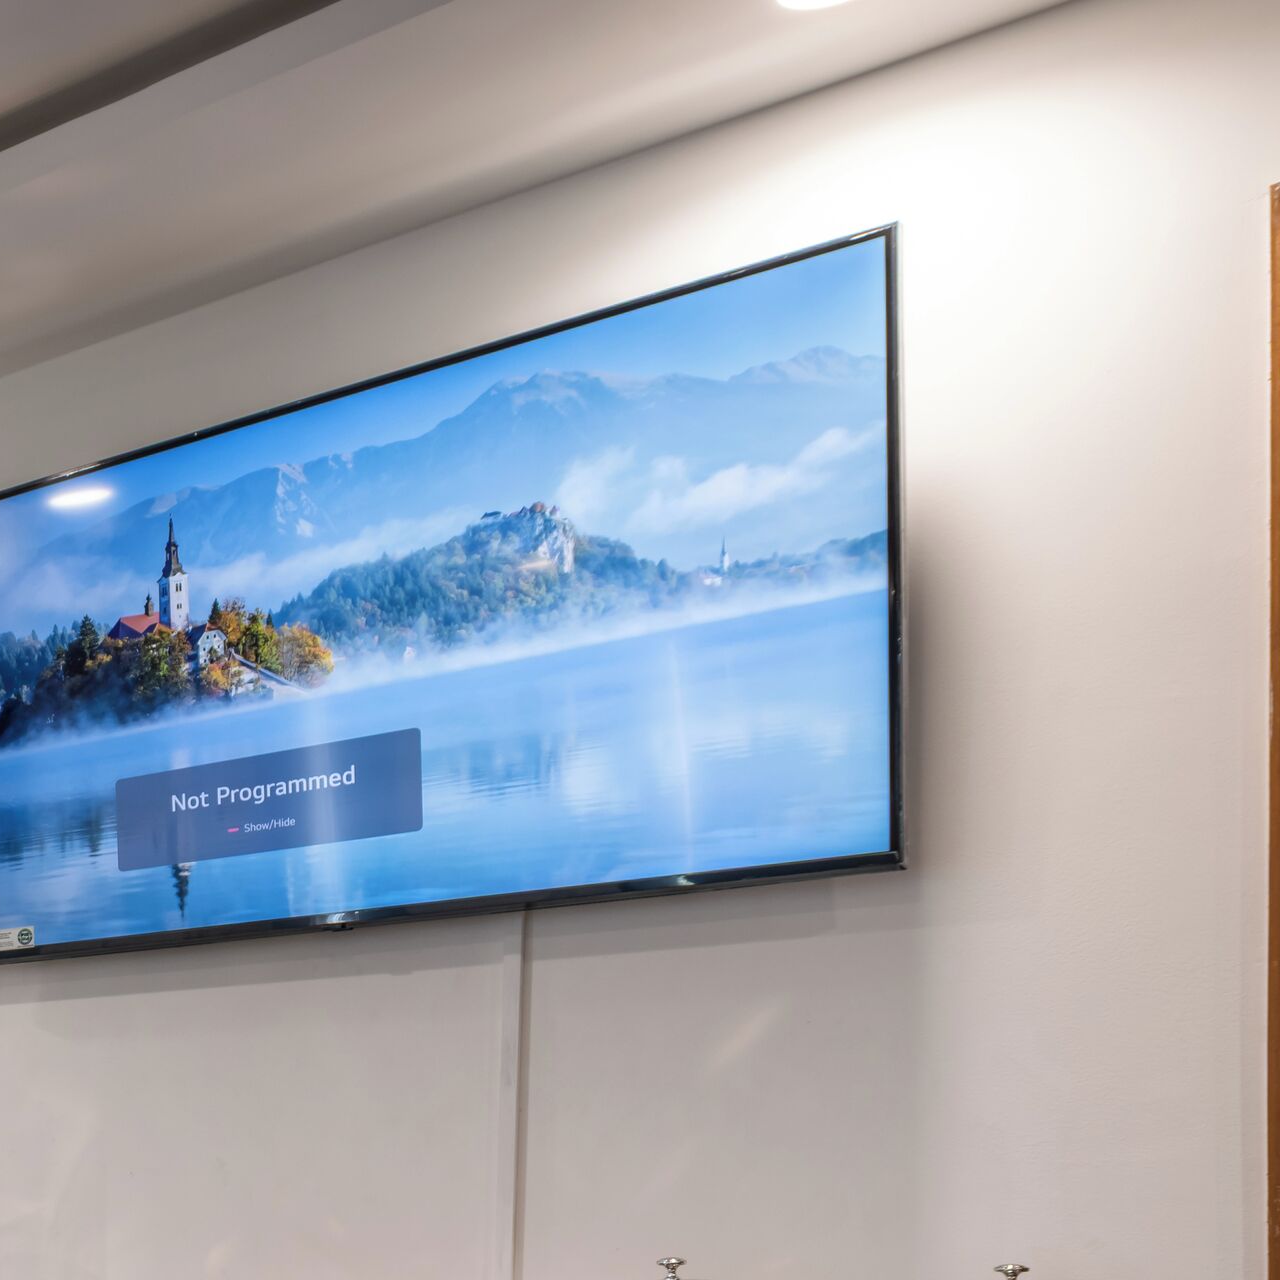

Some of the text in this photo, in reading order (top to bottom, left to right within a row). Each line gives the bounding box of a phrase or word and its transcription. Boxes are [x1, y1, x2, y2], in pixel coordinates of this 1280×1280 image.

[171, 764, 357, 812] Not Programmed
[244, 816, 297, 833] Show/Hide
